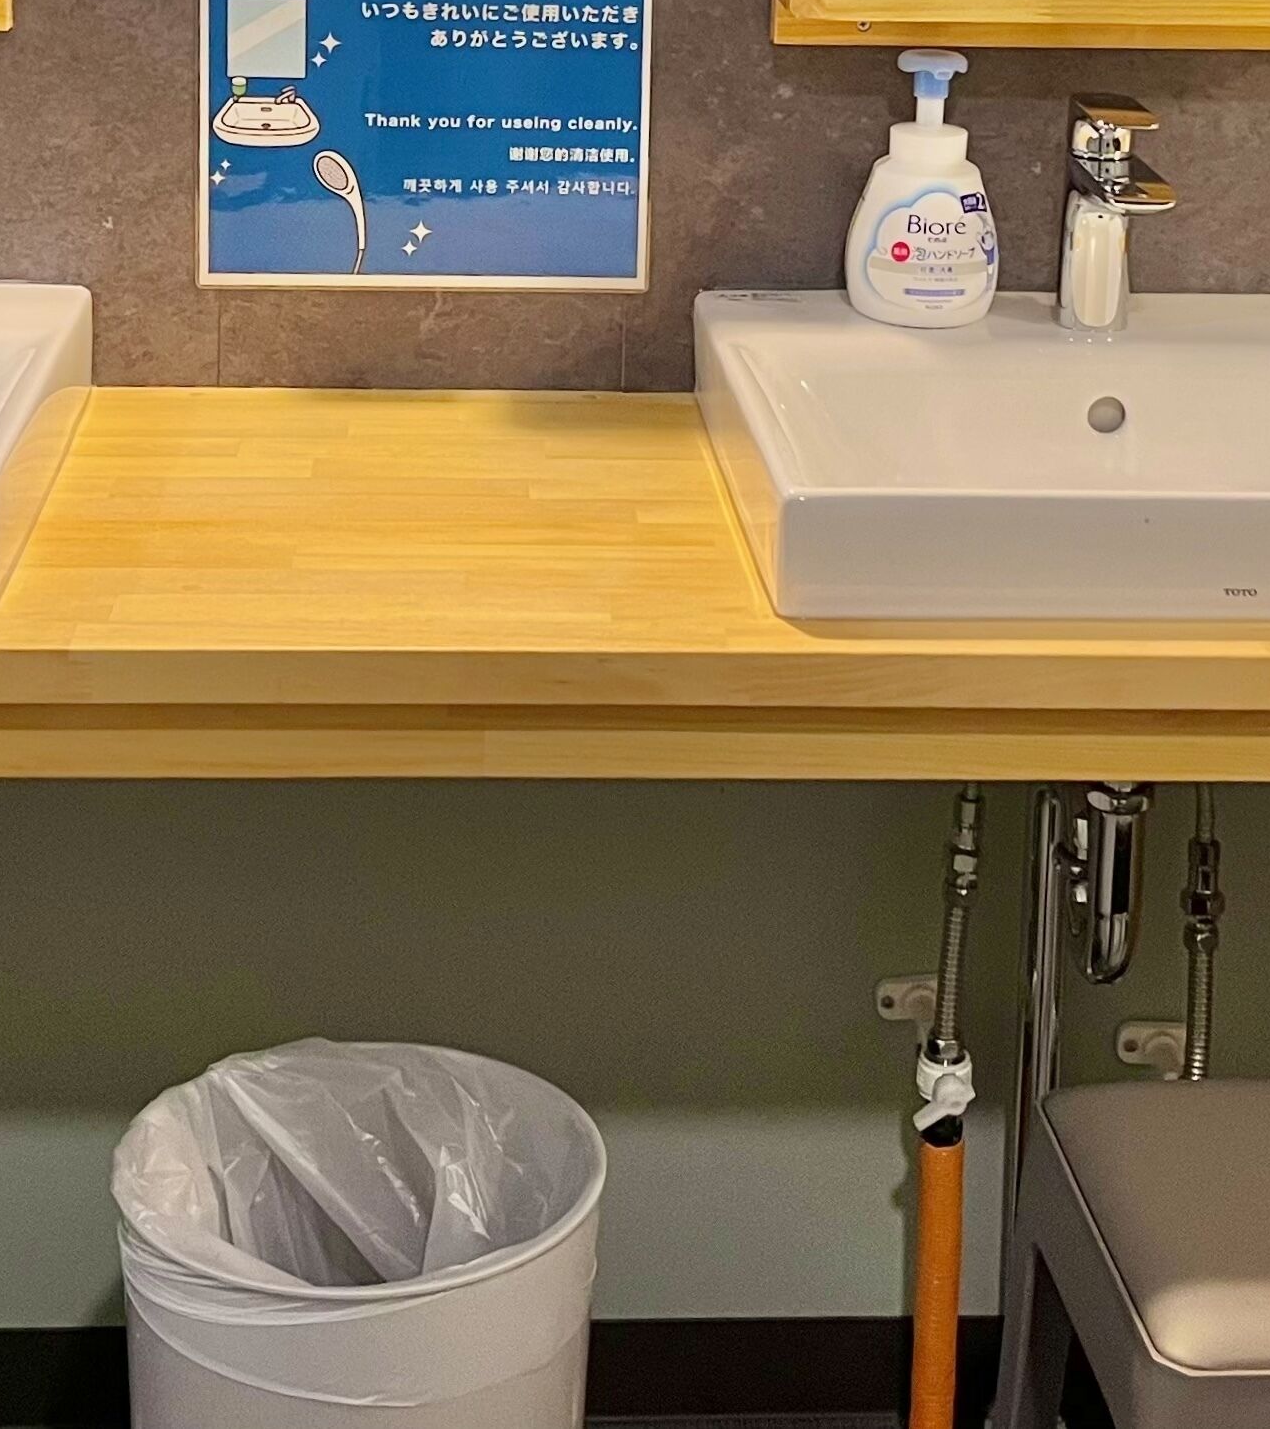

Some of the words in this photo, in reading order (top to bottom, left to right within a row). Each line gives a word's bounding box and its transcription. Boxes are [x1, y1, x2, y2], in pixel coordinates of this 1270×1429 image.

[361, 1, 639, 24] いつもきれいにご使用いただき
[430, 29, 638, 51] ありがとうございます。
[365, 112, 421, 128] Thank
[427, 117, 460, 130] you
[467, 114, 494, 128] for
[501, 117, 562, 132] useing
[567, 116, 638, 133] cleanly.
[469, 179, 498, 194] 사용
[907, 214, 967, 236] Bioré
[1222, 587, 1258, 597] TOTO
